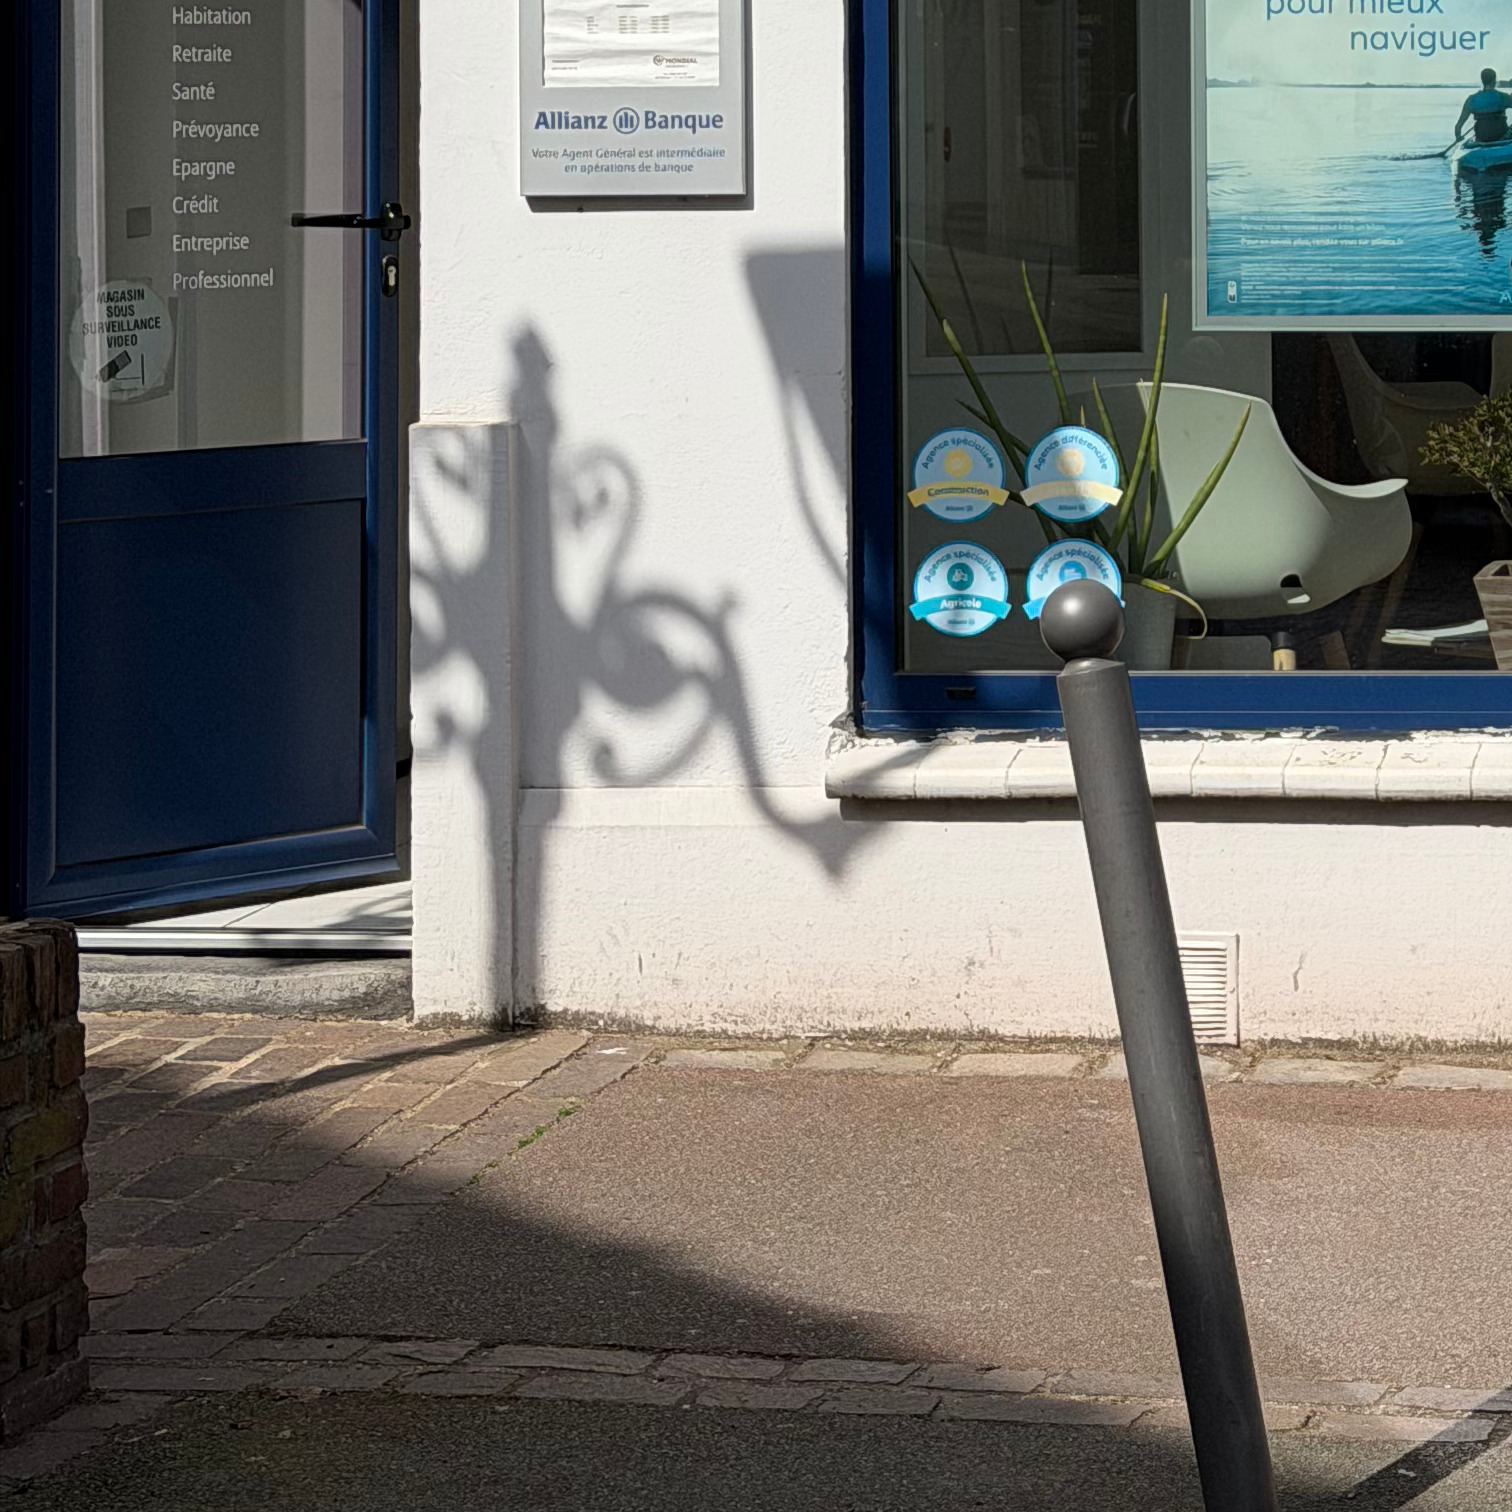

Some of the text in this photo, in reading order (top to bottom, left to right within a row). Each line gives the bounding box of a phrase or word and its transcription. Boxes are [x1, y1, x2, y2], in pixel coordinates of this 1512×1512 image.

[172, 6, 251, 25] Habitation
[1350, 23, 1490, 57] naviguer
[172, 44, 232, 63] Retraite
[172, 81, 215, 100] Santé
[173, 119, 260, 142] Prévoyance
[534, 109, 724, 134] Allianz Banque
[532, 146, 726, 161] Votre Agent Général est intermédiaire
[173, 159, 235, 181] Epargne
[564, 162, 694, 175] en opérations de banque
[173, 195, 219, 214] Crédit
[173, 234, 249, 255] Entreprise
[173, 268, 273, 290] Professionnel
[97, 288, 145, 304] MAGASIN
[106, 304, 136, 319] SOUS
[82, 316, 162, 336] SURVEILLANCE
[106, 333, 138, 348] VIDEO
[921, 436, 994, 470] Agence spécialisée
[1034, 439, 1060, 471] Agence
[924, 550, 997, 583] Agence spécialisée
[1036, 551, 1063, 581] Agence
[939, 599, 982, 609] Agricole
